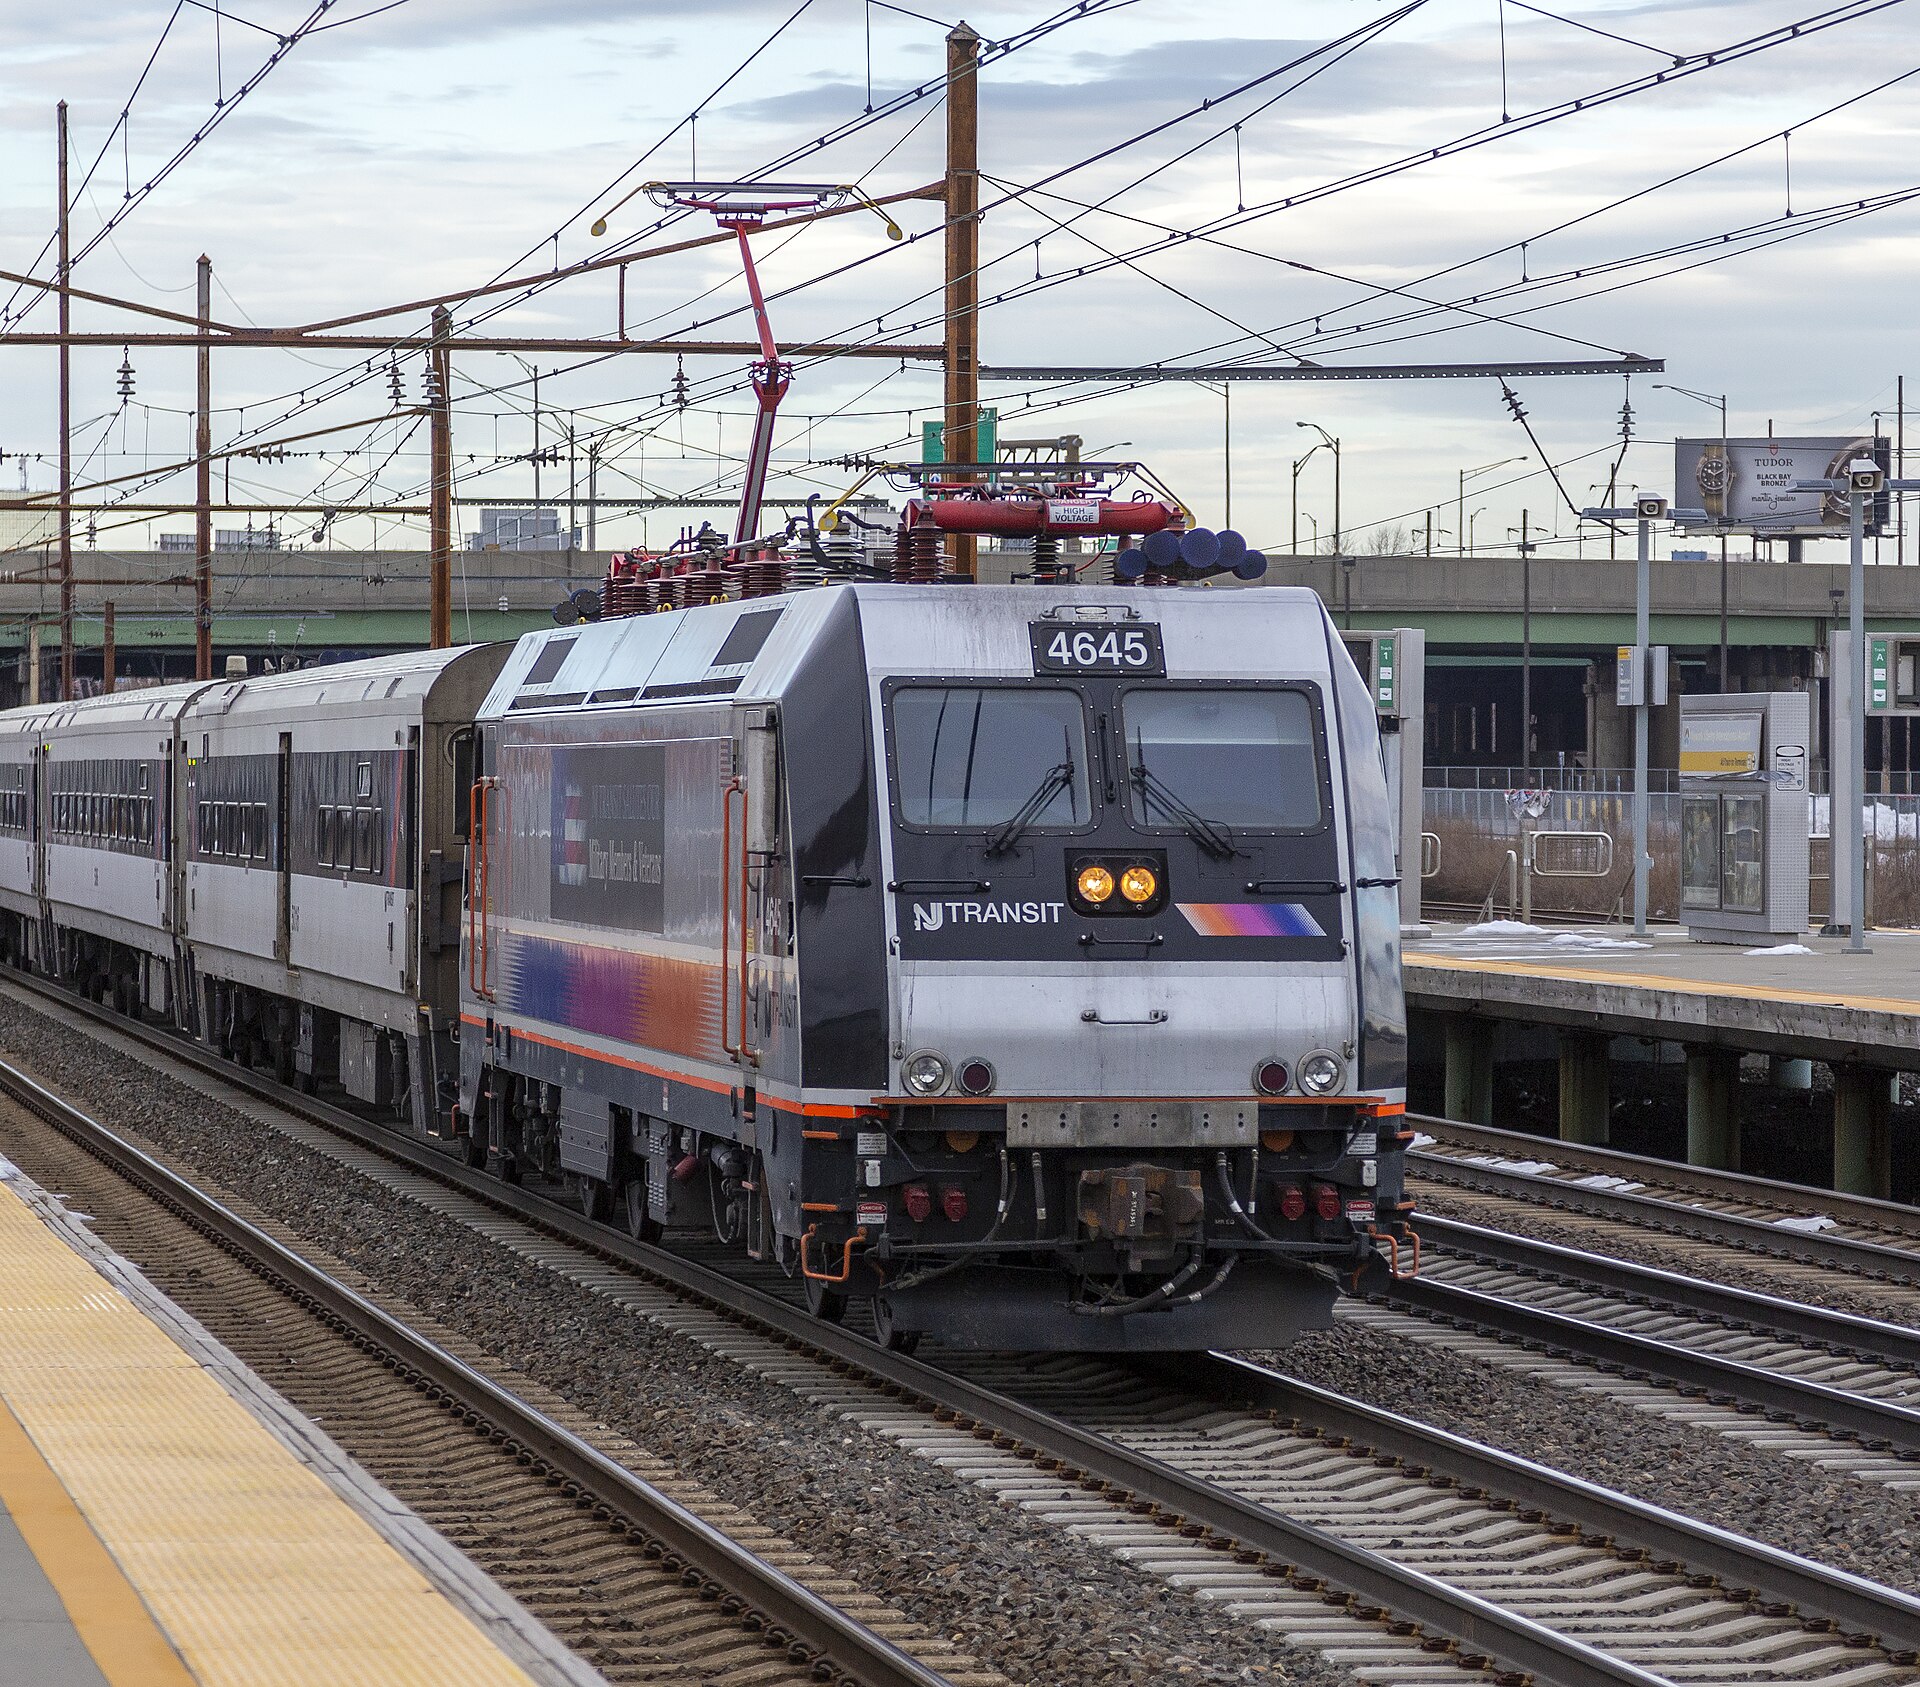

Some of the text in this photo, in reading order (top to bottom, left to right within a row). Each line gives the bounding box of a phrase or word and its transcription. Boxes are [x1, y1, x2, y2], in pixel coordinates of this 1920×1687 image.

[1754, 458, 1793, 467] TUDOR
[1055, 514, 1094, 522] VOLTAGE
[1047, 631, 1148, 666] 4645
[1383, 651, 1388, 660] 1
[1876, 653, 1884, 662] A
[633, 840, 638, 882] &
[765, 897, 781, 936] 4645
[913, 902, 1065, 931] NJ TRANSIT
